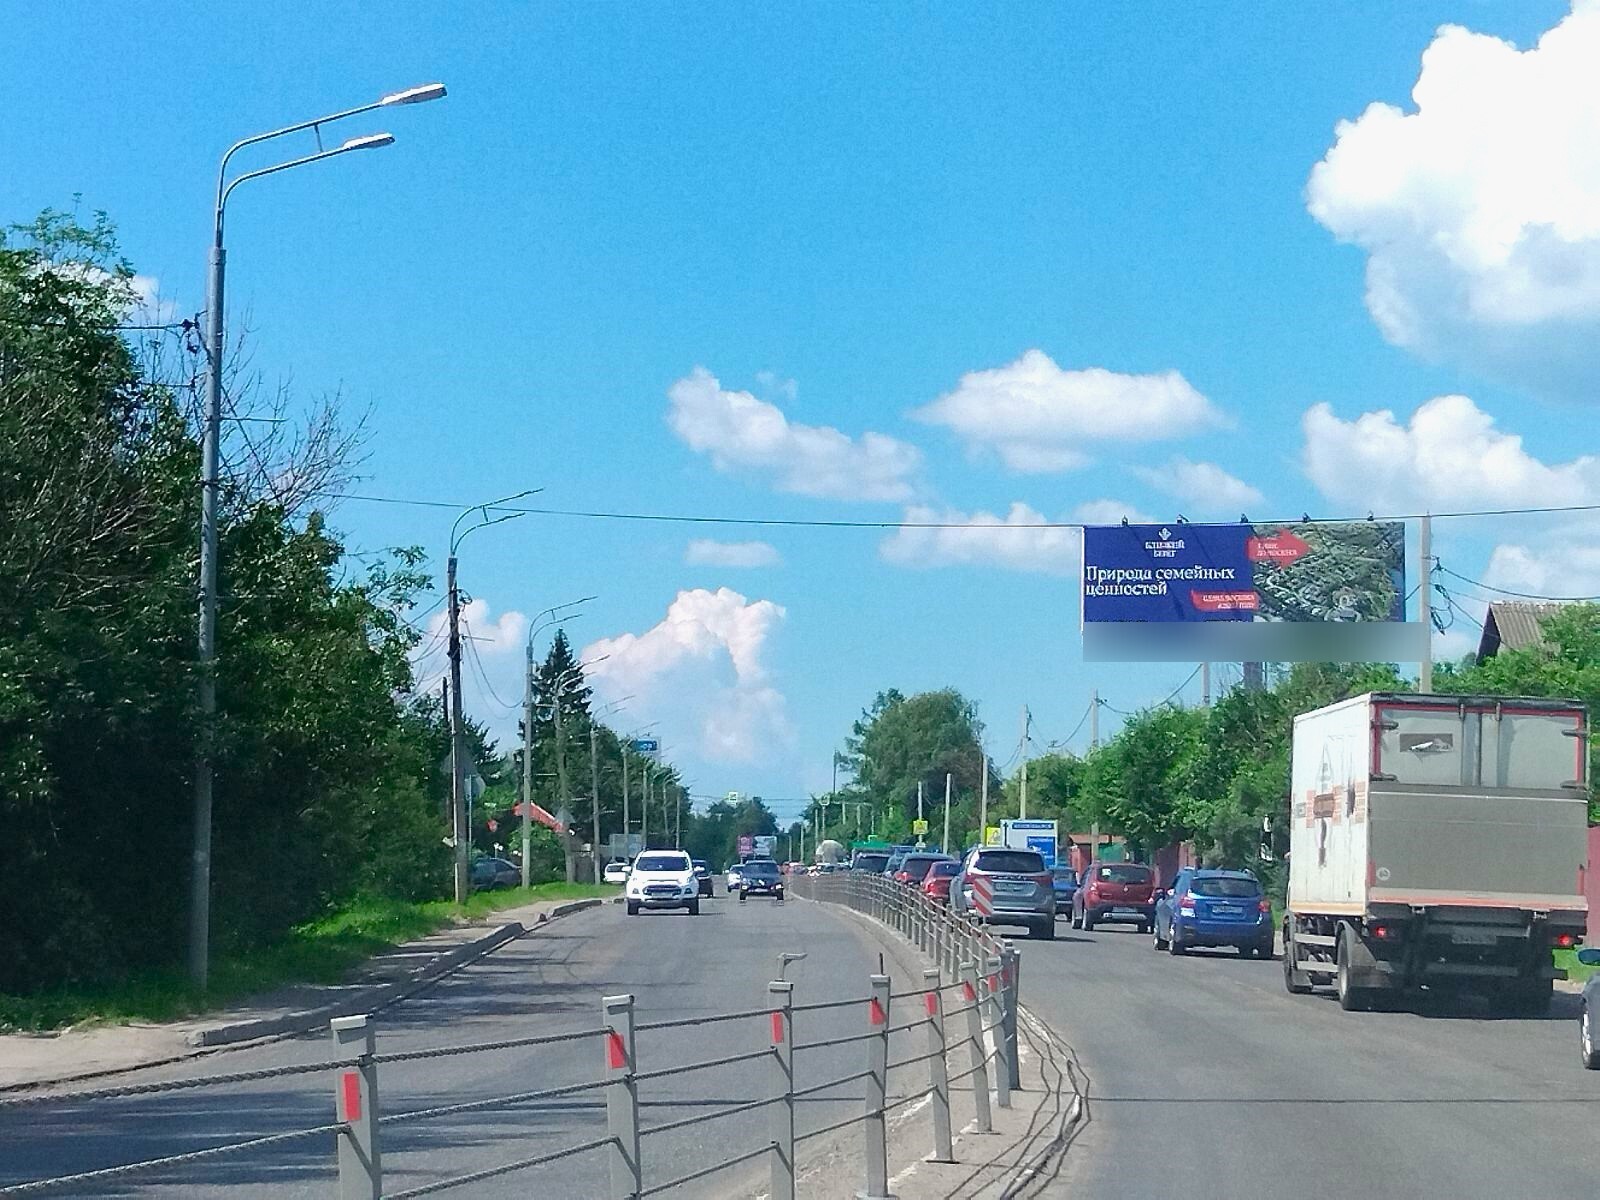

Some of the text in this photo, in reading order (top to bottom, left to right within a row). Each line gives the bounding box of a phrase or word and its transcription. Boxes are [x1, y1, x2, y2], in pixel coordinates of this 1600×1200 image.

[1086, 565, 1235, 586] Природа семейных
[1085, 581, 1167, 596] ценностей
